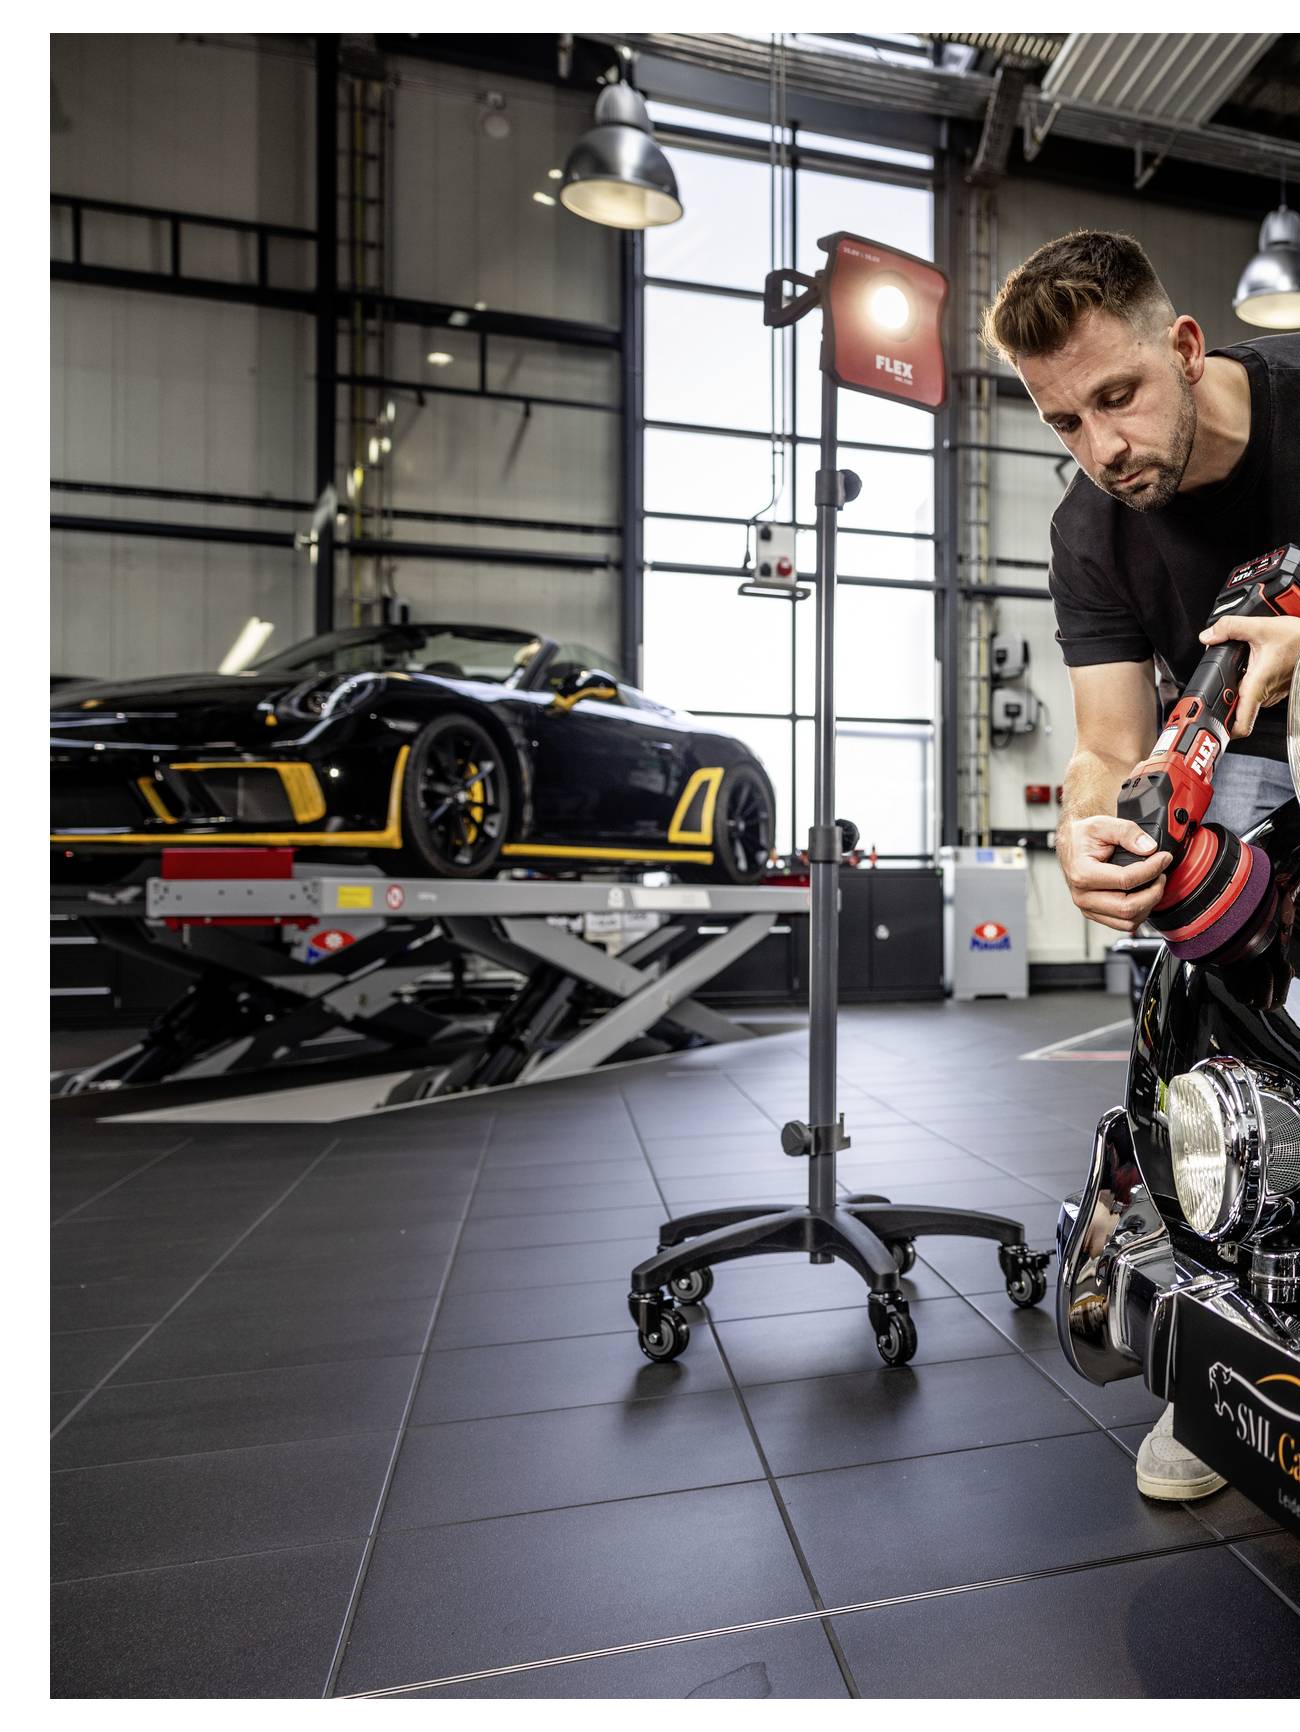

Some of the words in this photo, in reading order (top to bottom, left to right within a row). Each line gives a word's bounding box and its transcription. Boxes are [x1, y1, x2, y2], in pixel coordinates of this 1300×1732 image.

[875, 354, 913, 379] FLEX
[1190, 735, 1217, 776] FLEX
[1236, 1402, 1276, 1463] SML
